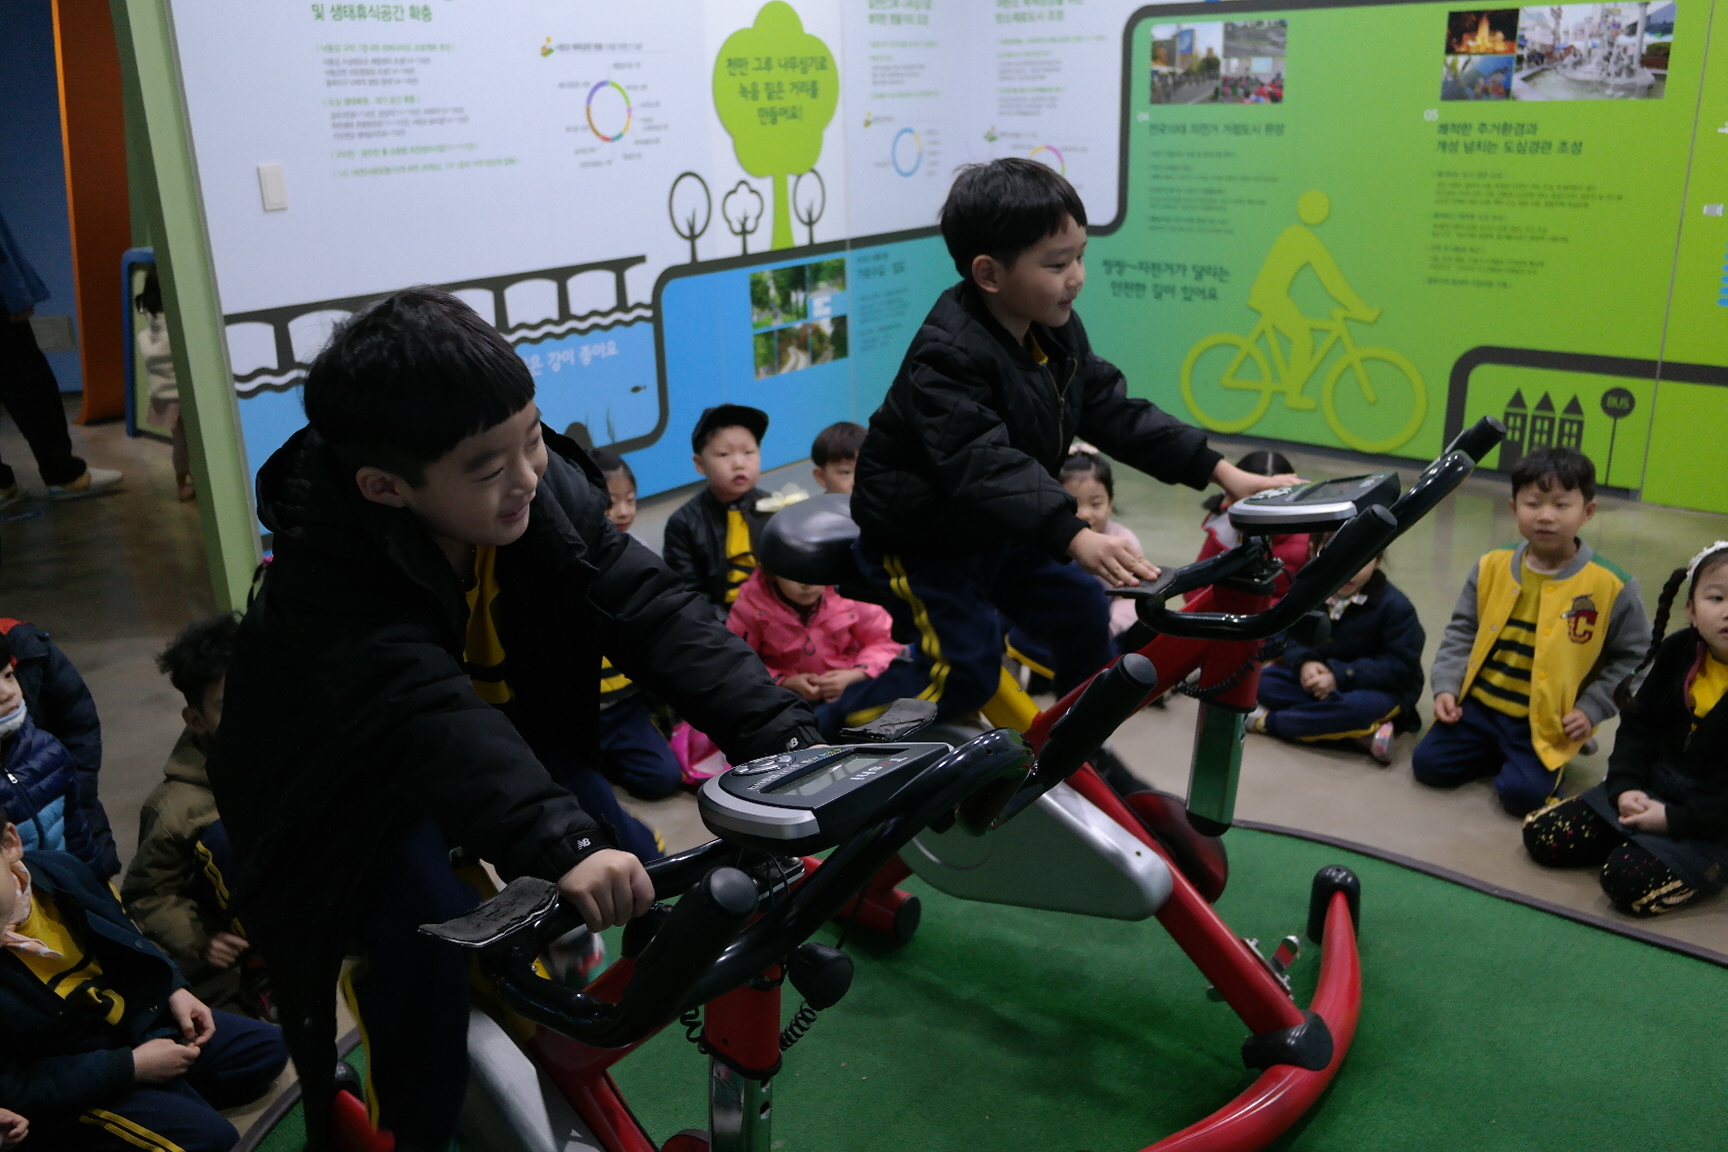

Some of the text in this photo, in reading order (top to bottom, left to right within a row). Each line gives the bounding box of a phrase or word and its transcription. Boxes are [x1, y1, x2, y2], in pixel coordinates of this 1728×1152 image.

[311, 3, 433, 22] 및 생태휴식공간 확충
[752, 56, 774, 73] 그루
[524, 340, 620, 377] 은 강이 좋아요
